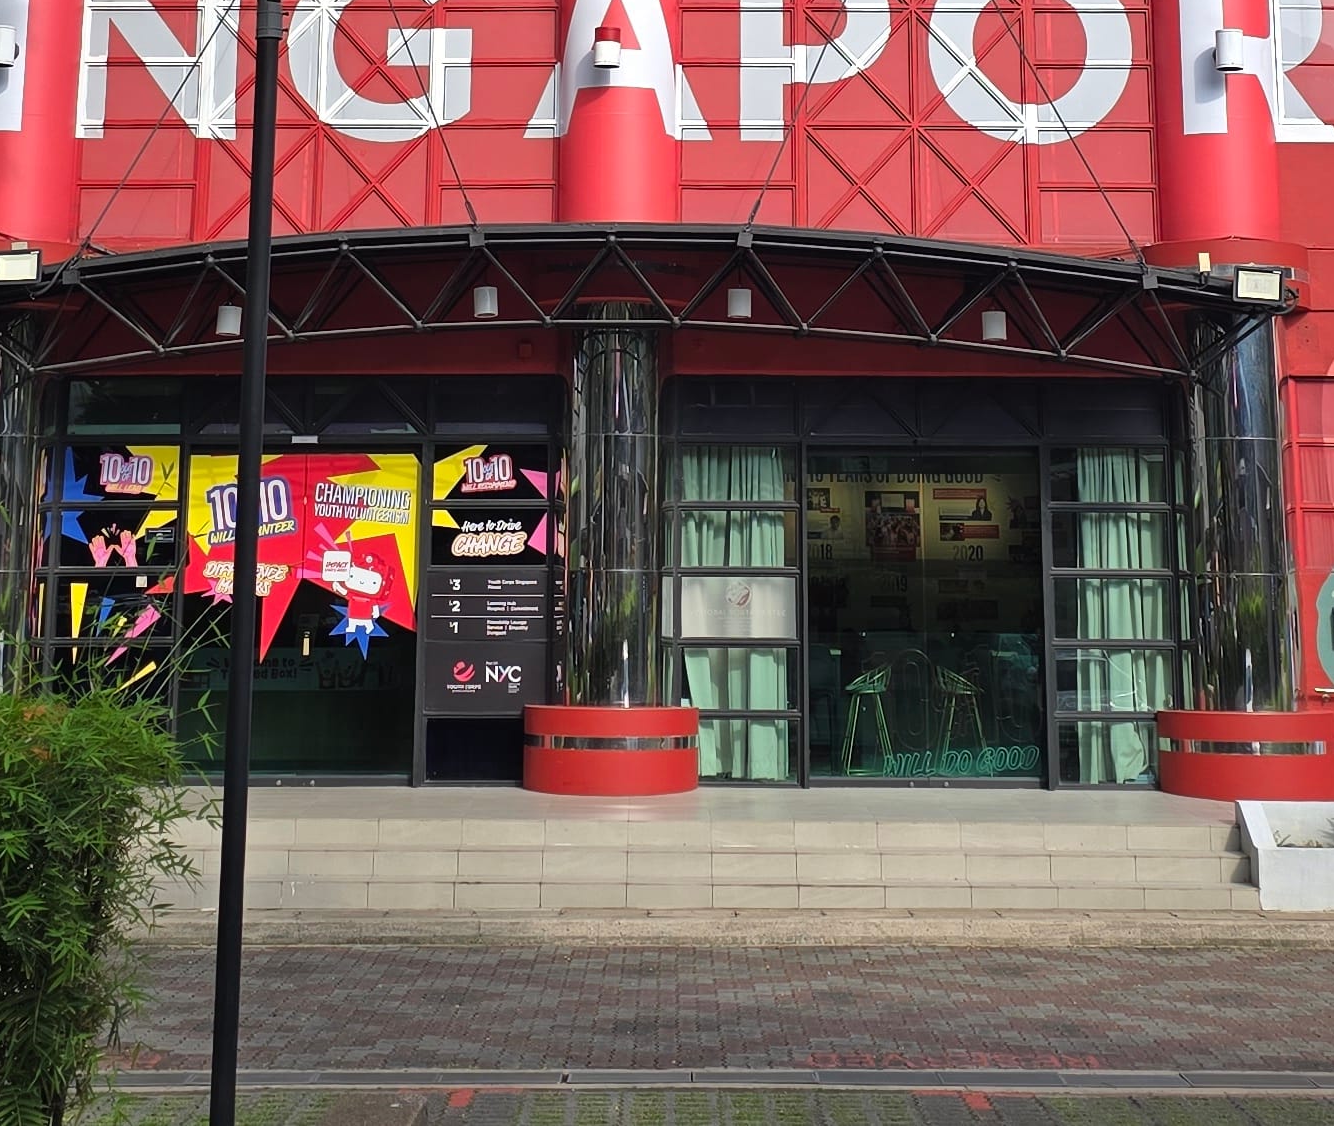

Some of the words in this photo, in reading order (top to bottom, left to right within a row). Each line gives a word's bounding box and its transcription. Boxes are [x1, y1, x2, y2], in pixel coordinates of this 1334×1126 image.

[101, 455, 122, 483] 10
[130, 457, 151, 485] 10
[465, 458, 484, 484] 10
[489, 455, 512, 481] 10
[315, 482, 411, 510] CHAMPIONING
[314, 503, 342, 519] YOUTH
[344, 505, 409, 525] VOLUNTEERISM
[461, 520, 485, 532] Here
[495, 518, 522, 530] Drive
[210, 530, 235, 544] WILL
[452, 532, 527, 557] CHANGE
[485, 665, 521, 683] NYC
[941, 749, 973, 775] DO
[976, 746, 1040, 774] GOOD
